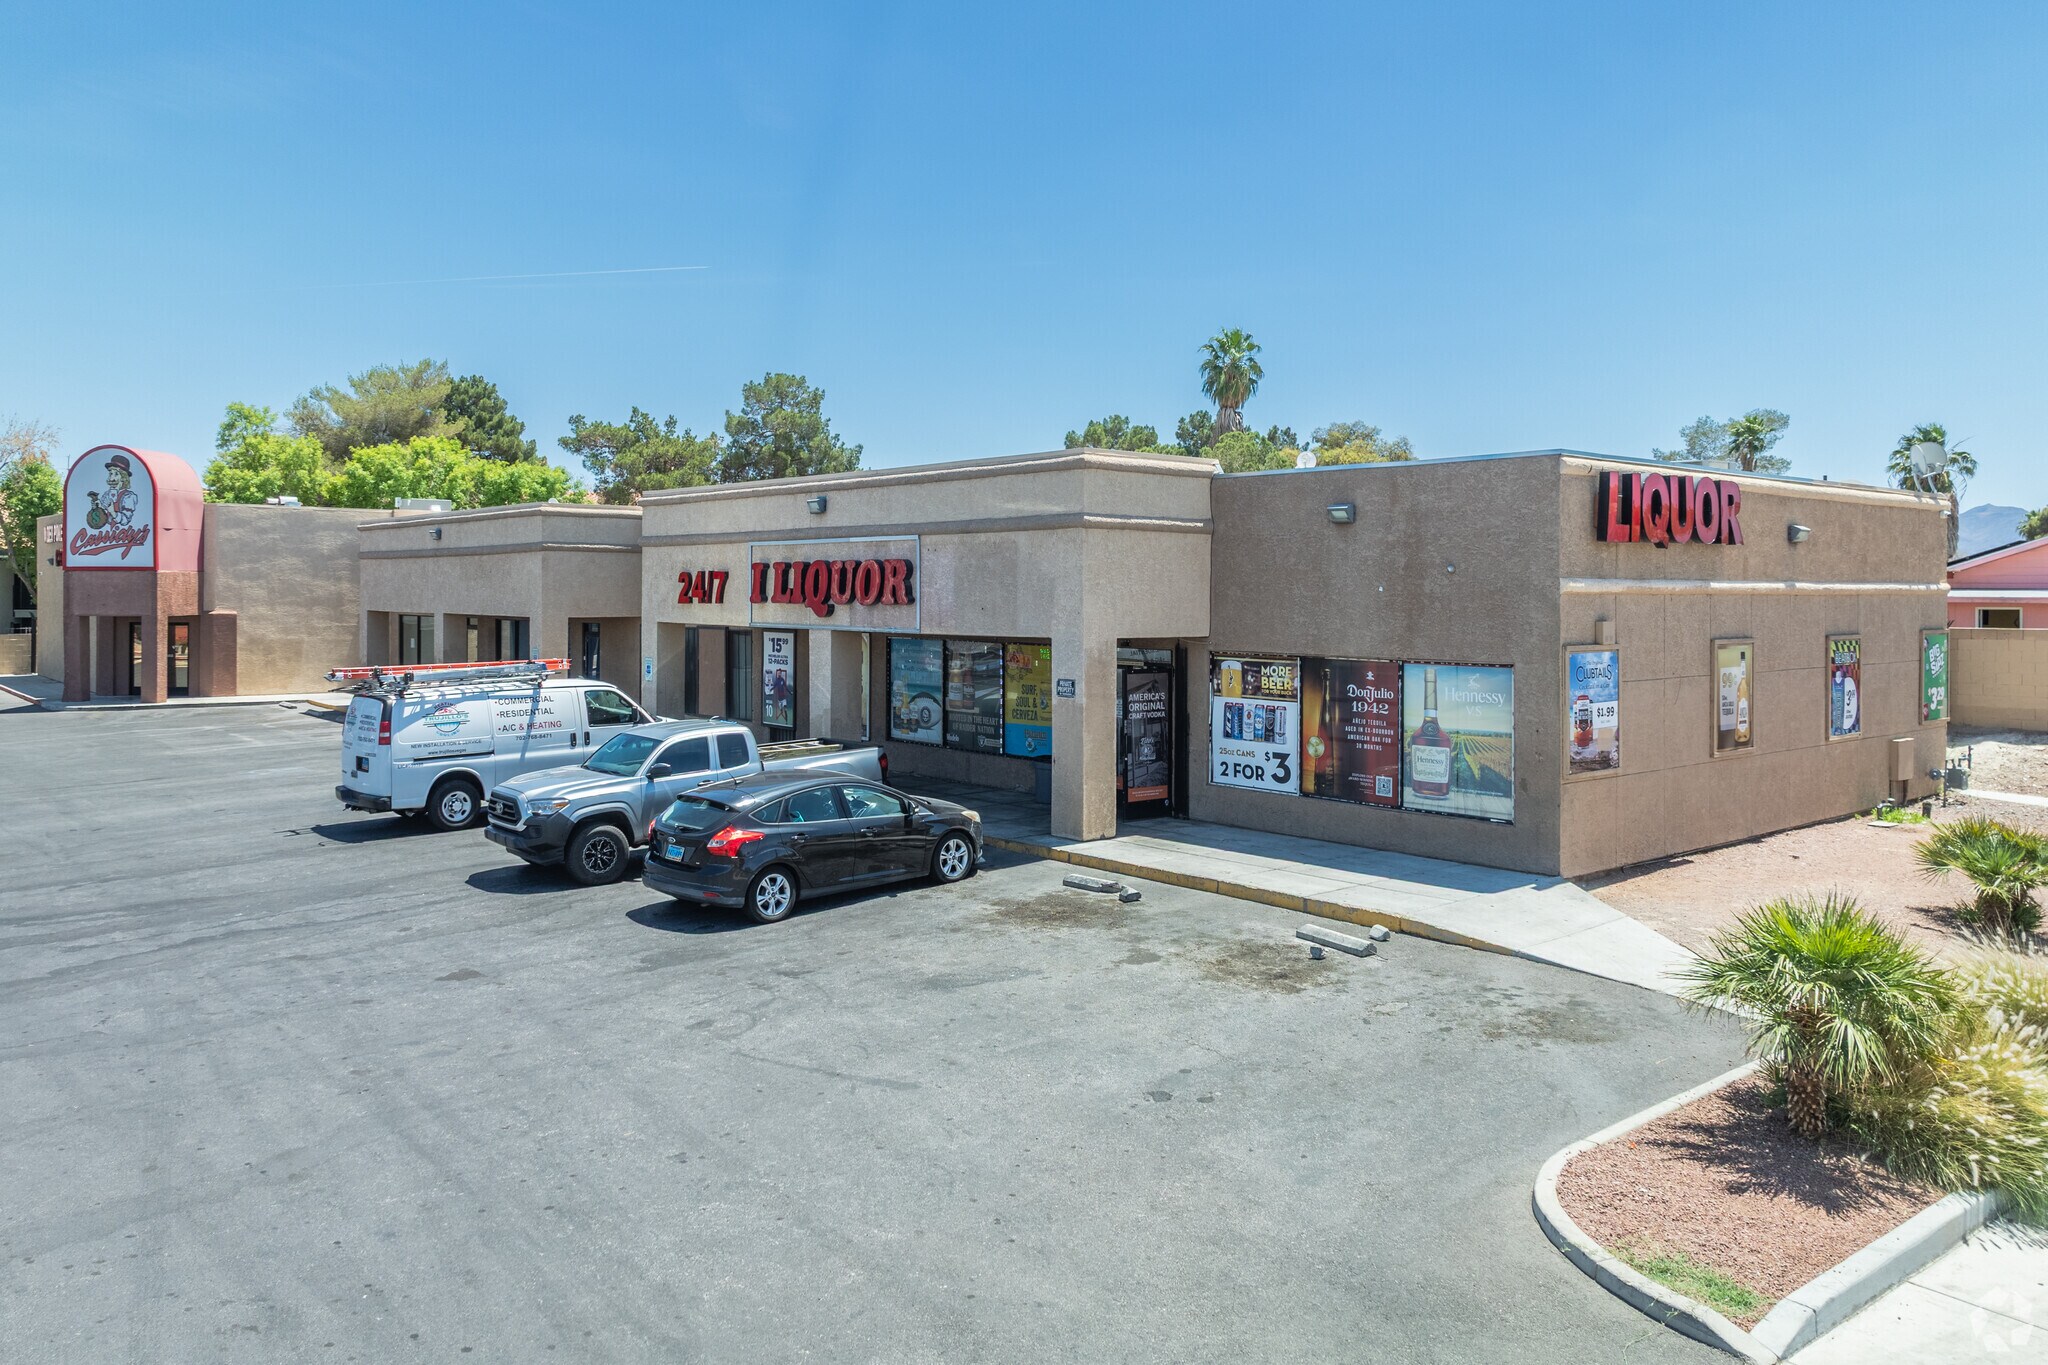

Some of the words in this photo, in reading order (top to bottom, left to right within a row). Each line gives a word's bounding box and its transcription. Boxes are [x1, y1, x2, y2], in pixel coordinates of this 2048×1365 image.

[1597, 471, 1744, 549] LIQUOR
[70, 524, 151, 560] Cassidy's
[771, 559, 916, 617] LIQUOR
[1261, 665, 1292, 677] MORE
[1261, 676, 1293, 690] BEER
[498, 696, 554, 705] COMMERCIAL
[1128, 693, 1165, 702] AMERICA'S
[1445, 687, 1506, 707] Hennessy
[500, 708, 554, 718] RESIDENTIAL
[1128, 702, 1165, 712] ORIGINAL
[1352, 701, 1389, 714] 1942
[1597, 707, 1614, 718] $1.99
[1012, 708, 1038, 721] CERVEZA
[502, 723, 516, 732] A/C
[519, 723, 524, 731] &
[527, 720, 562, 730] HEATING
[1236, 749, 1255, 758] CANS
[1416, 755, 1444, 766] Hennessy
[1220, 761, 1229, 777] 2
[1233, 762, 1265, 782] FOR
